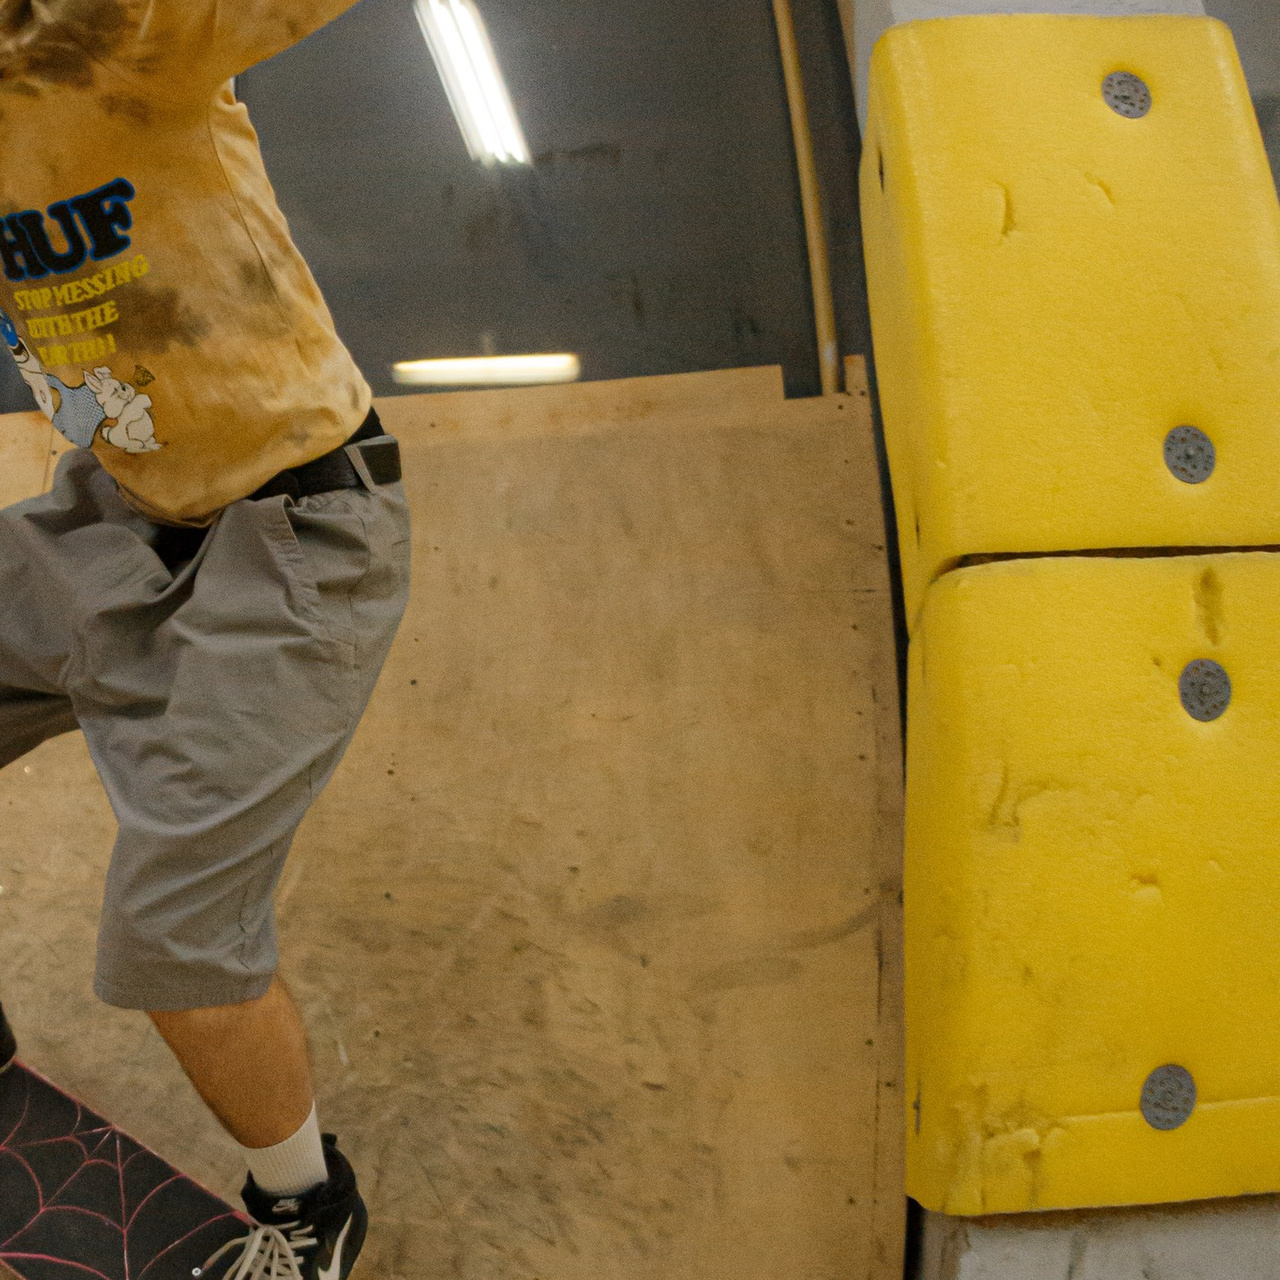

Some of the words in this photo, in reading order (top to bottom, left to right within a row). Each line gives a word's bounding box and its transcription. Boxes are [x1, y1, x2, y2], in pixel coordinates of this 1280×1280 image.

[14, 288, 52, 310] STOP
[52, 254, 149, 306] MESSING
[26, 315, 73, 338] WITH
[70, 301, 119, 333] THE
